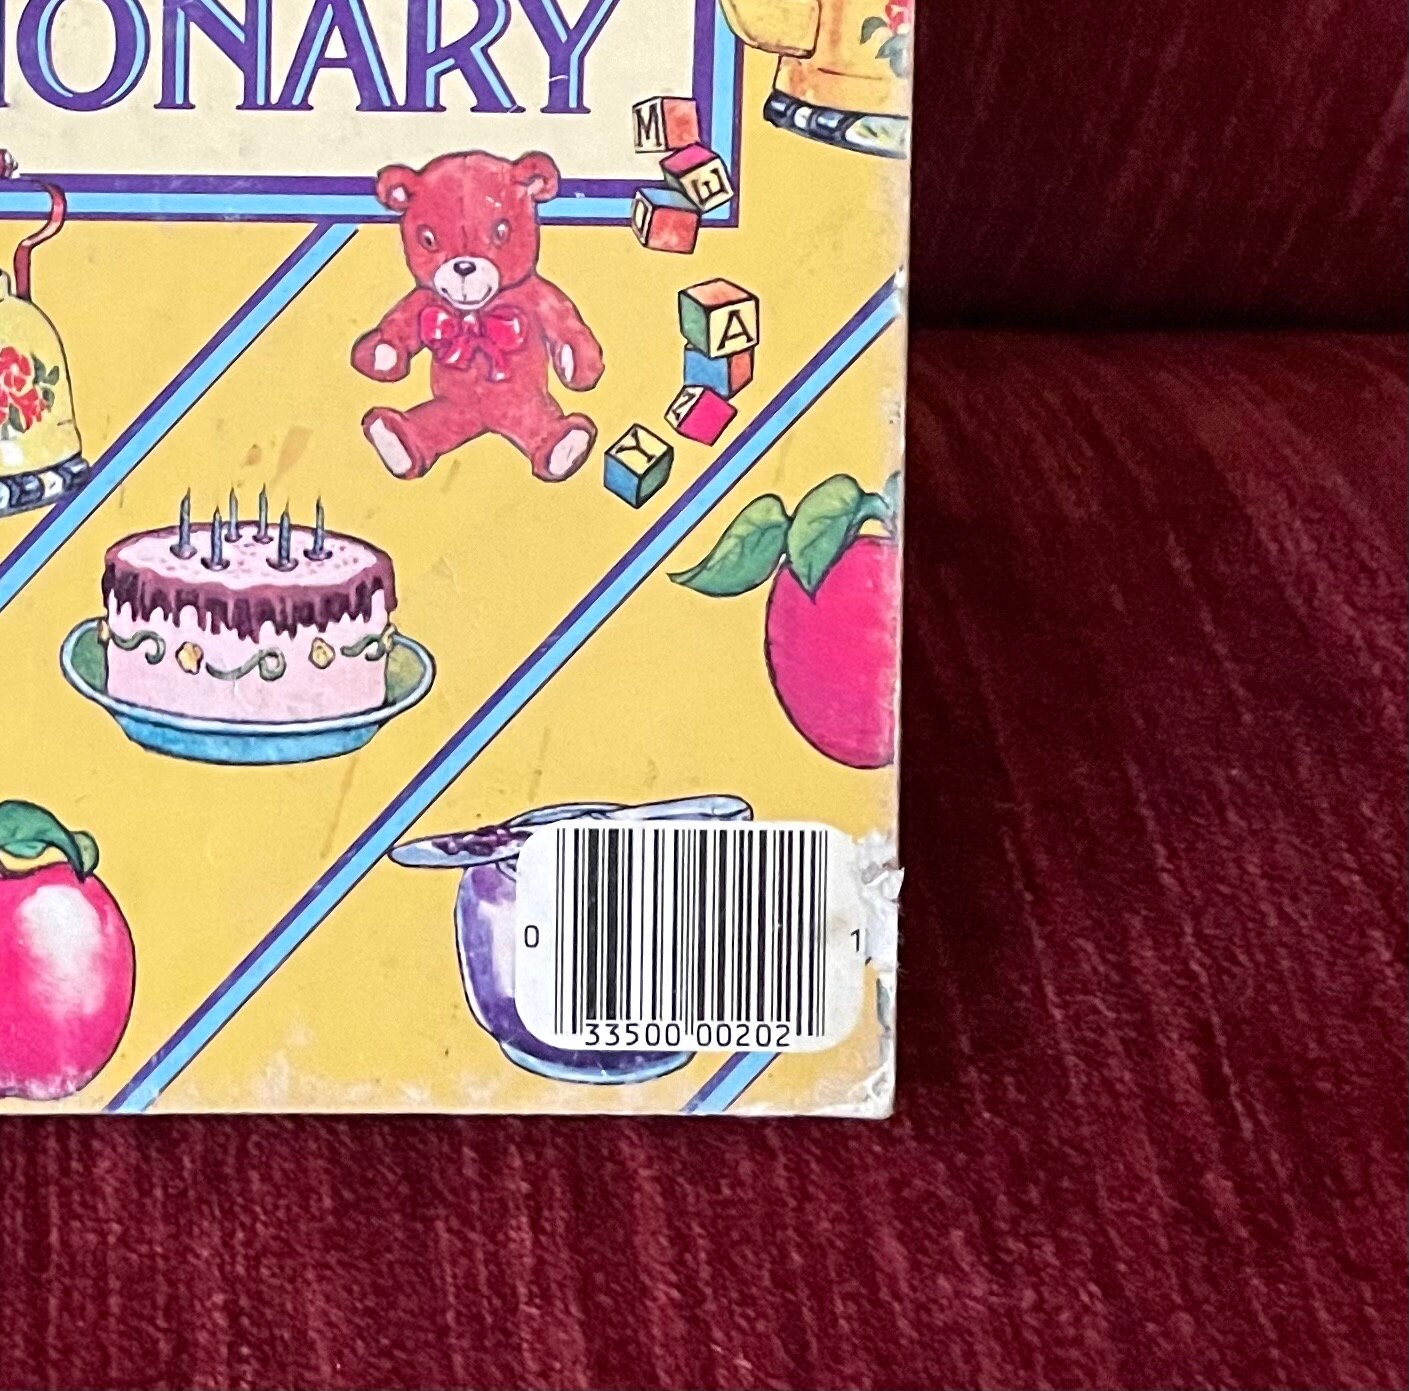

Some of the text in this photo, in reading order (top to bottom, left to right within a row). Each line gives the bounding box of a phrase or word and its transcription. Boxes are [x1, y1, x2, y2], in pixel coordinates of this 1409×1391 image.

[716, 308, 754, 352] A
[584, 1023, 682, 1048] 33500
[696, 1024, 791, 1048] 00202
